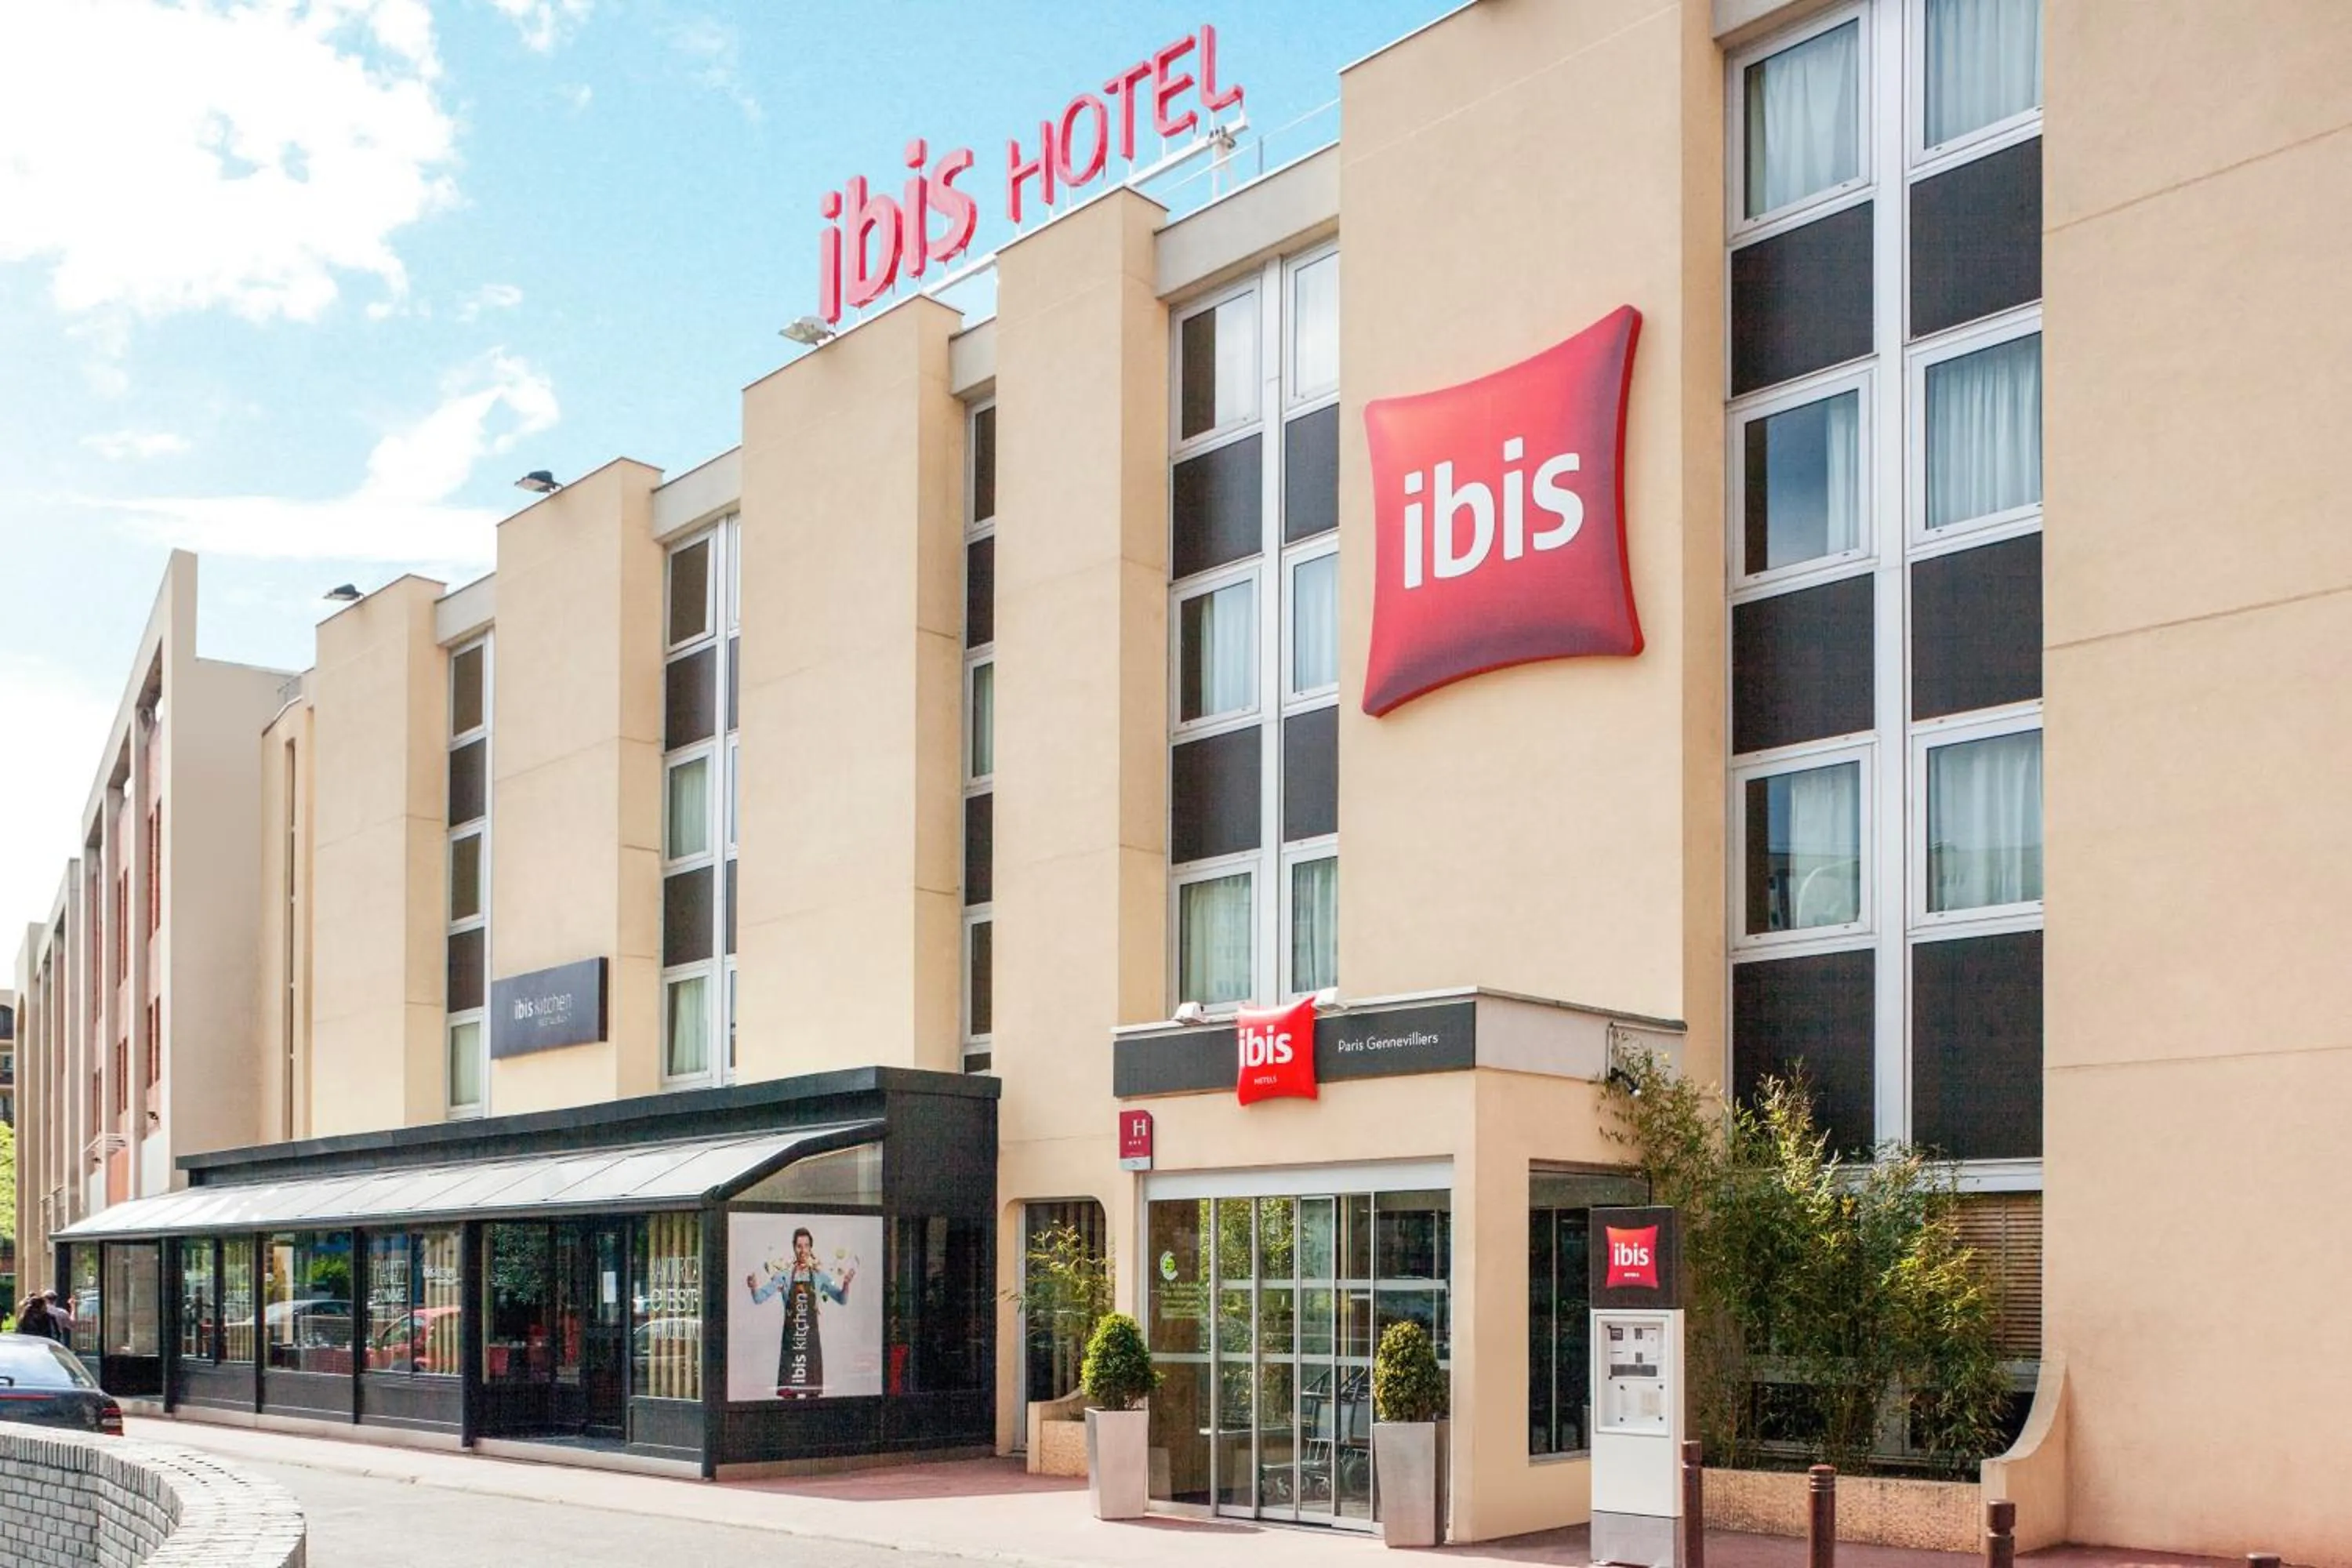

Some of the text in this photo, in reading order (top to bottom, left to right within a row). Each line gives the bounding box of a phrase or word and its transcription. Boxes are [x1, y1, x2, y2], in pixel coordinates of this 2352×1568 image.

[819, 24, 1244, 326] ibis HOTEL
[1404, 436, 1584, 590] ibis
[514, 997, 533, 1020] ibis
[1239, 1024, 1294, 1067] ibis
[1338, 1031, 1439, 1052] Paris Gennevilliers
[1133, 1118, 1146, 1138] H
[1613, 1242, 1650, 1266] ibis
[791, 1293, 810, 1385] ibis kitchen
